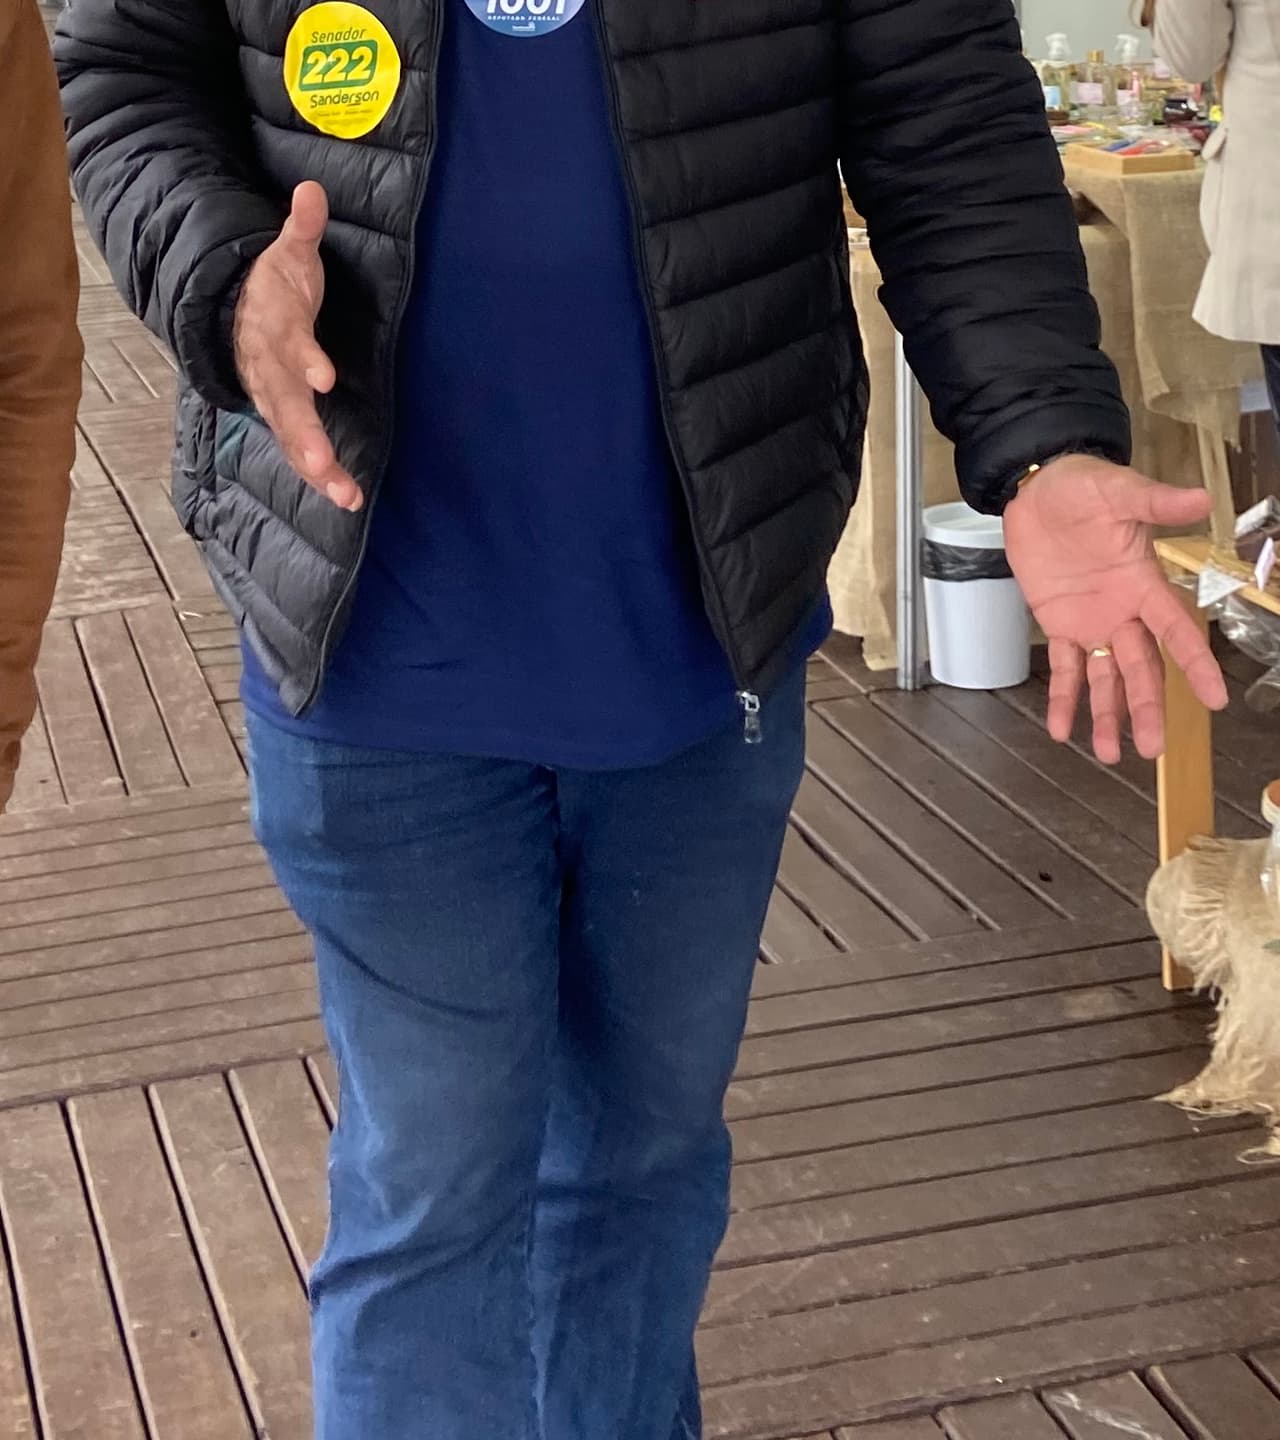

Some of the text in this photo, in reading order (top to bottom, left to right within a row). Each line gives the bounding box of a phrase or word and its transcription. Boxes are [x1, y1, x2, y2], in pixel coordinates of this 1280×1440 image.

[311, 27, 367, 44] Senador
[301, 46, 373, 85] 222
[310, 89, 380, 109] Sanderson
